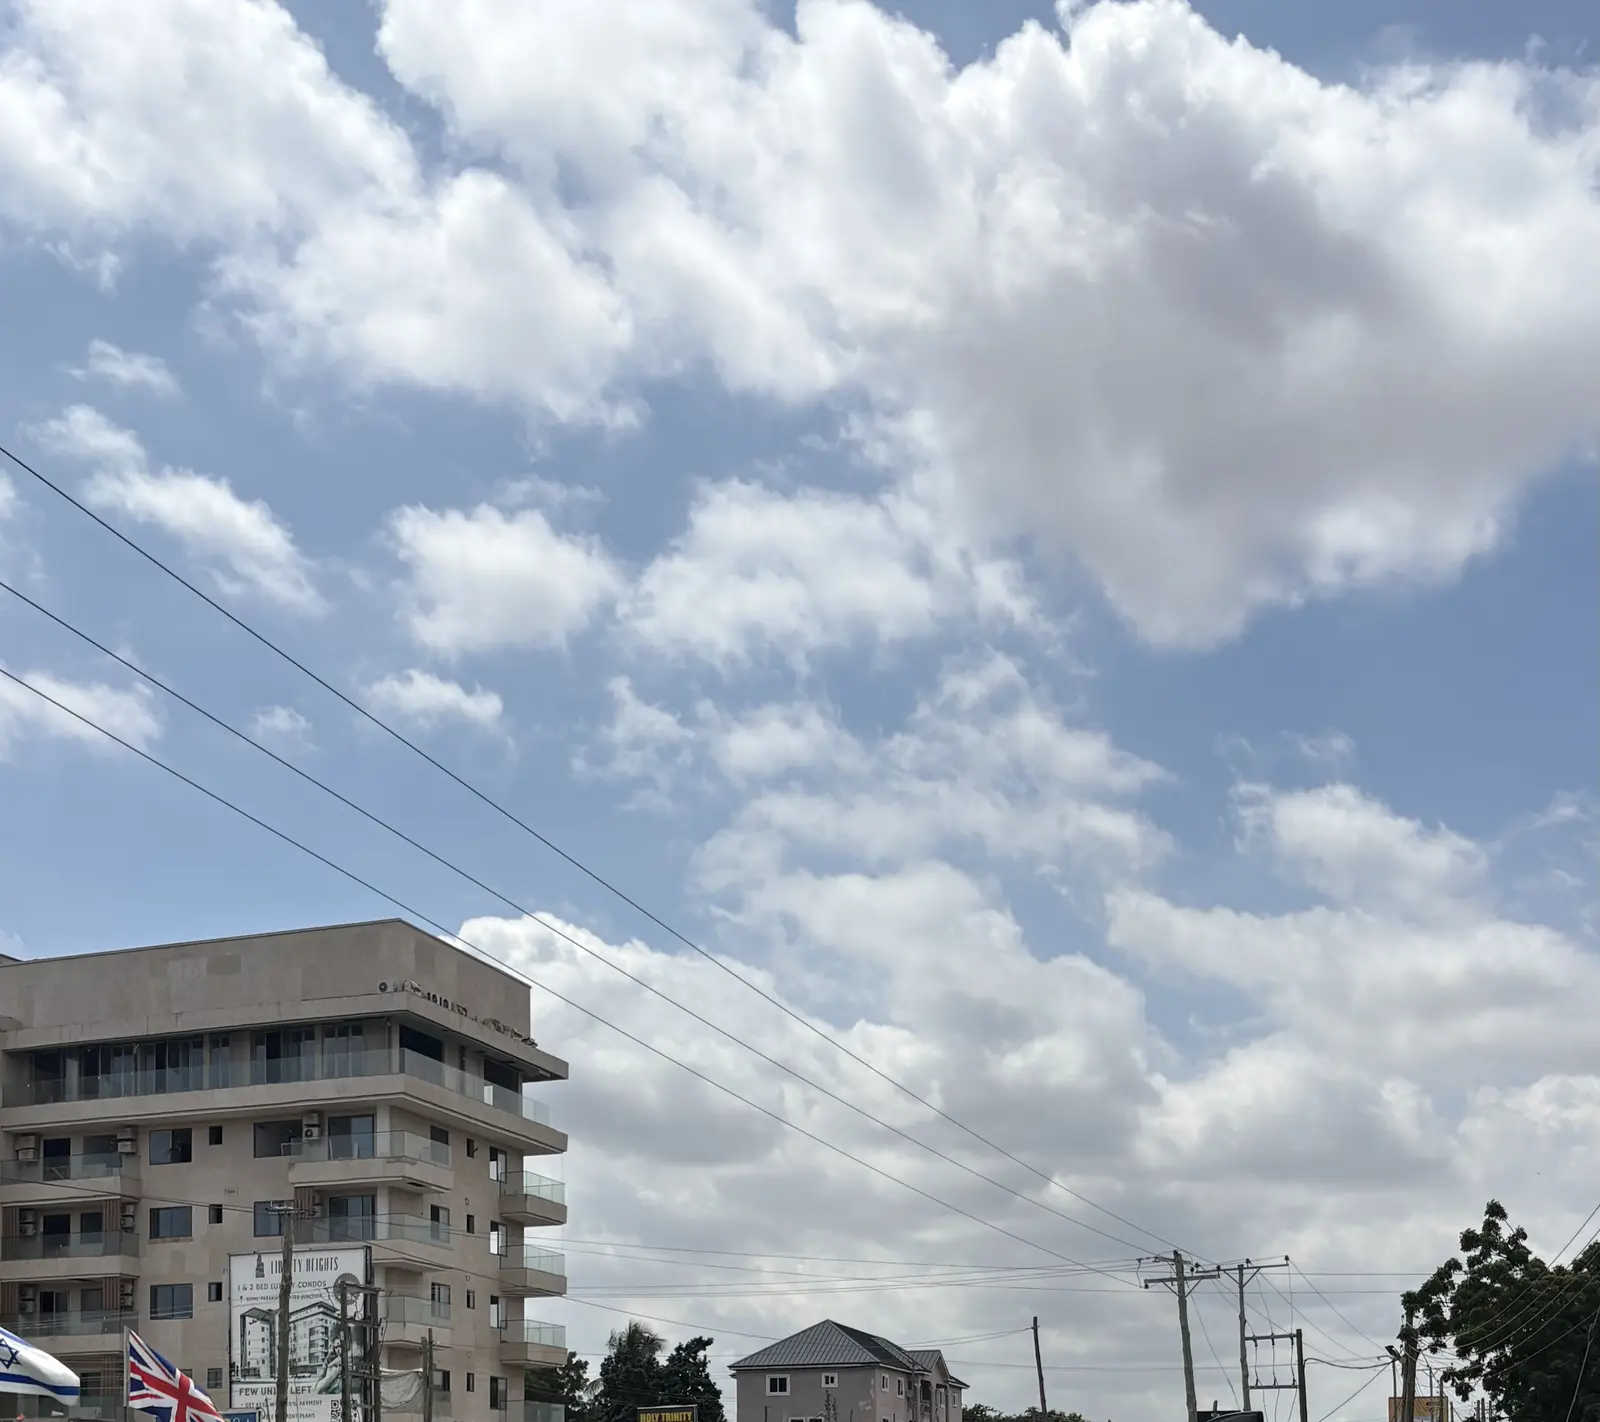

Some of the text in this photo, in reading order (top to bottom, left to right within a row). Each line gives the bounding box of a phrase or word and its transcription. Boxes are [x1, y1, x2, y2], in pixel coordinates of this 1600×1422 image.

[270, 1257, 339, 1274] LIBTY HEIGHTS
[297, 1280, 327, 1288] CONDOS
[239, 1386, 312, 1396] FEW UNI LEFT
[640, 1412, 692, 1422] HOLY TRINITY
